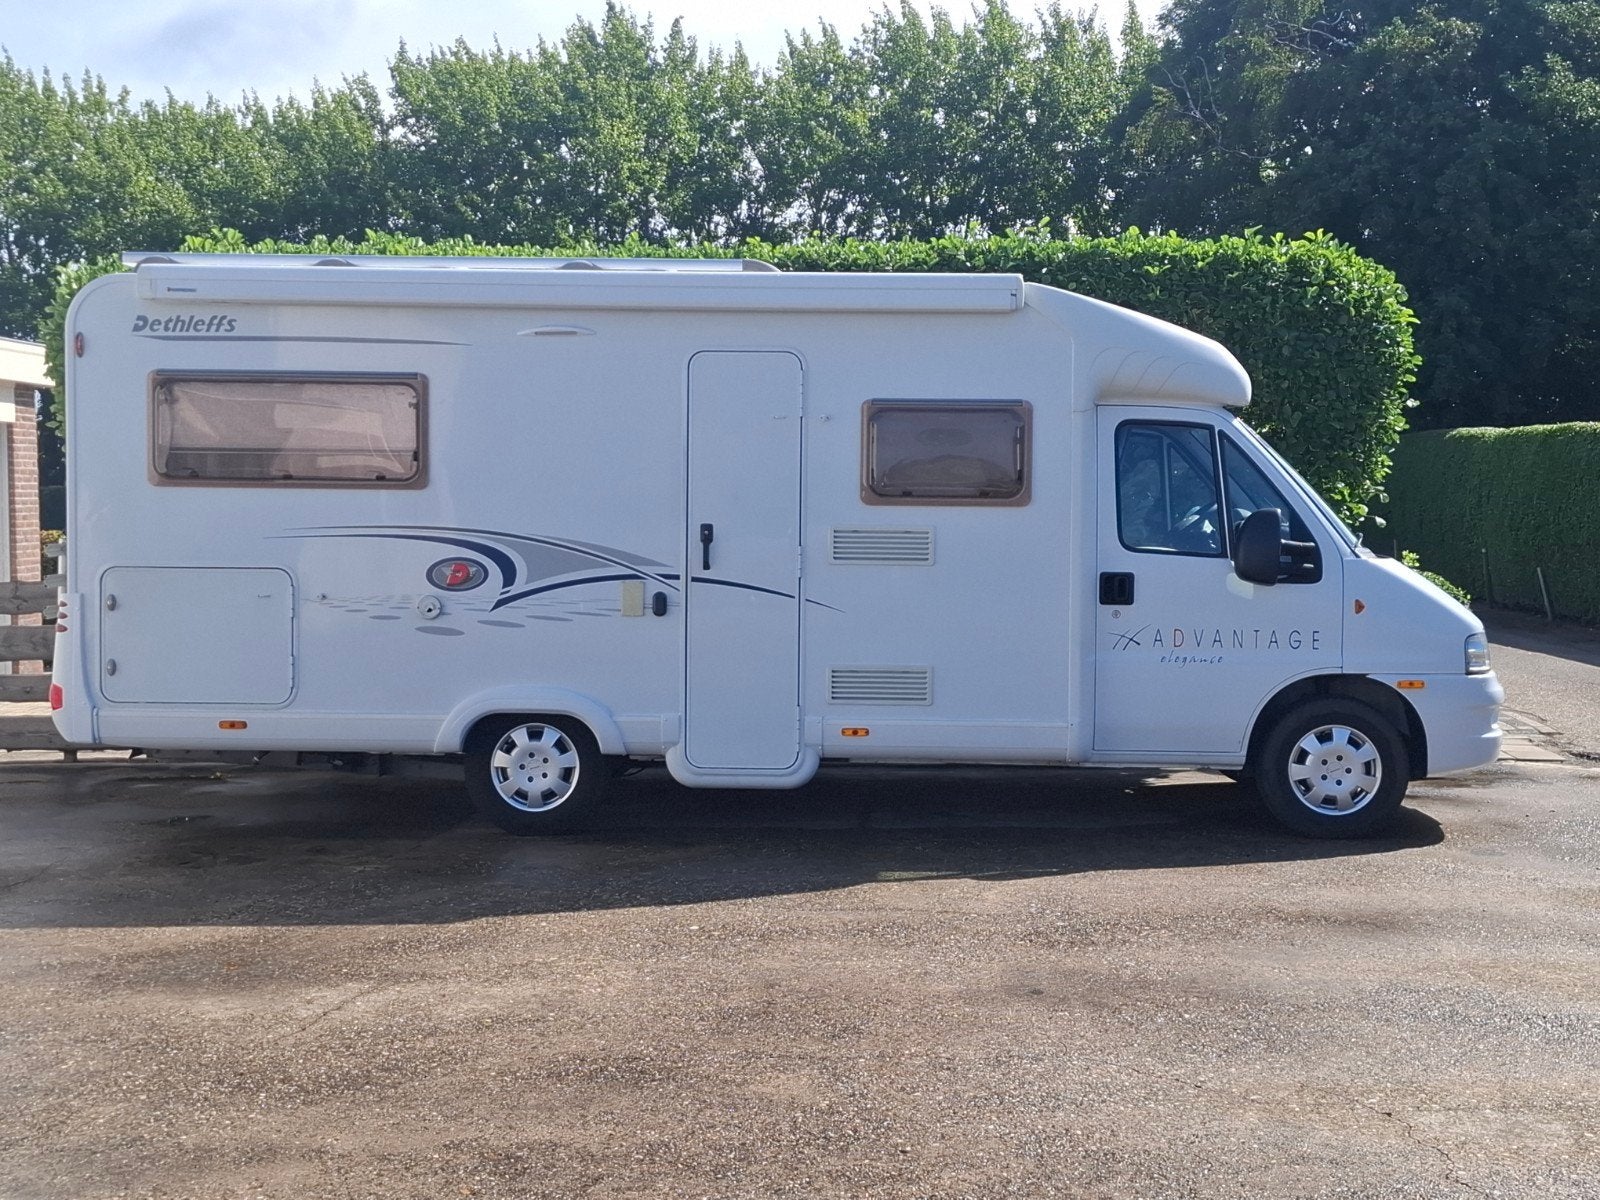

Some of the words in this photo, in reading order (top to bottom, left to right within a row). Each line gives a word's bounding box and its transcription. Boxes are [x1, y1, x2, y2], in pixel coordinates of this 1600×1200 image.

[132, 315, 237, 332] Dethleffs
[1152, 628, 1320, 650] ADVANTAGE
[1160, 650, 1223, 668] elegance
